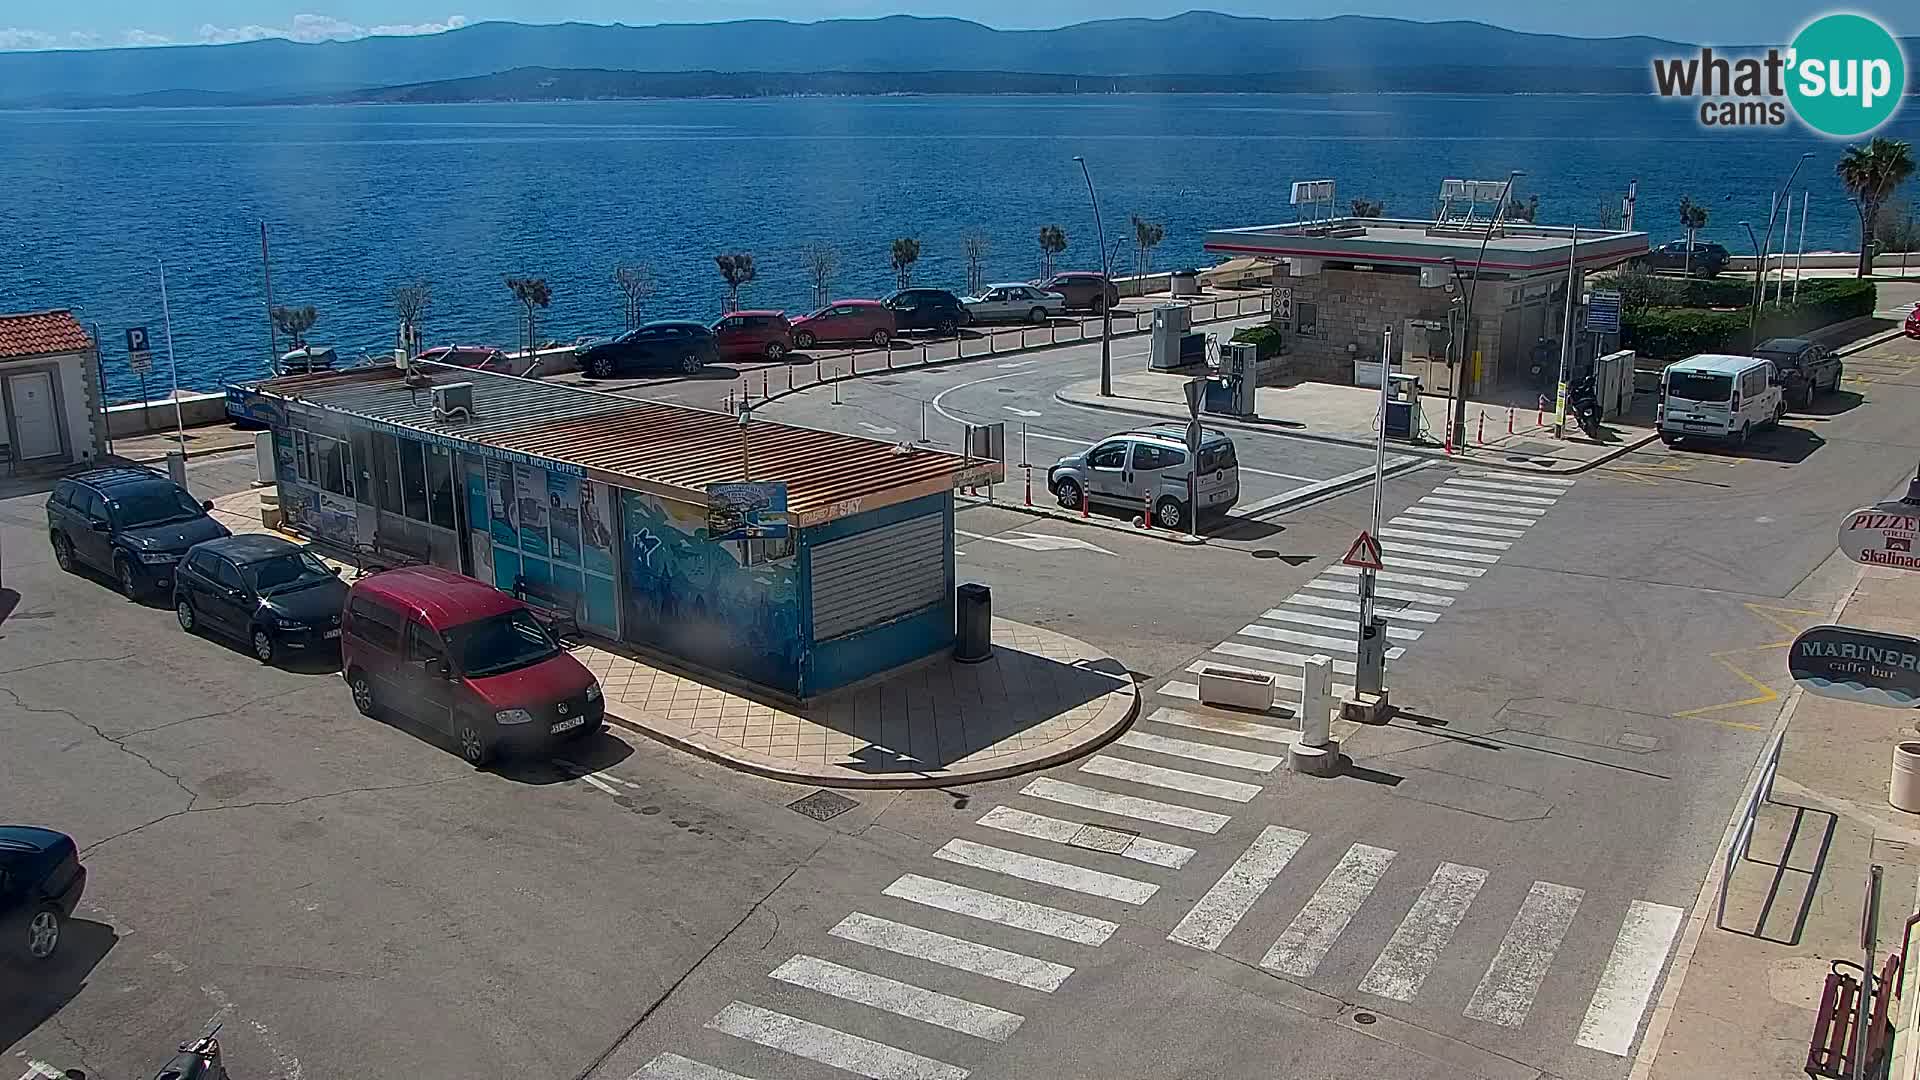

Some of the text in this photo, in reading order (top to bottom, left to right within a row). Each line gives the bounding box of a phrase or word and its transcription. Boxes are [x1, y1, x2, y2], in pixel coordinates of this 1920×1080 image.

[131, 330, 143, 348] P
[398, 427, 436, 444] AUTOBUSNA
[437, 437, 469, 451] POSTAJA
[479, 445, 494, 457] BUS
[496, 449, 527, 464] STATION
[529, 457, 555, 469] TICKET
[556, 462, 583, 475] OFFICE
[1848, 514, 1920, 531] PIZZE
[1801, 641, 1920, 672] MARINER
[1829, 662, 1896, 679] caffe bar
